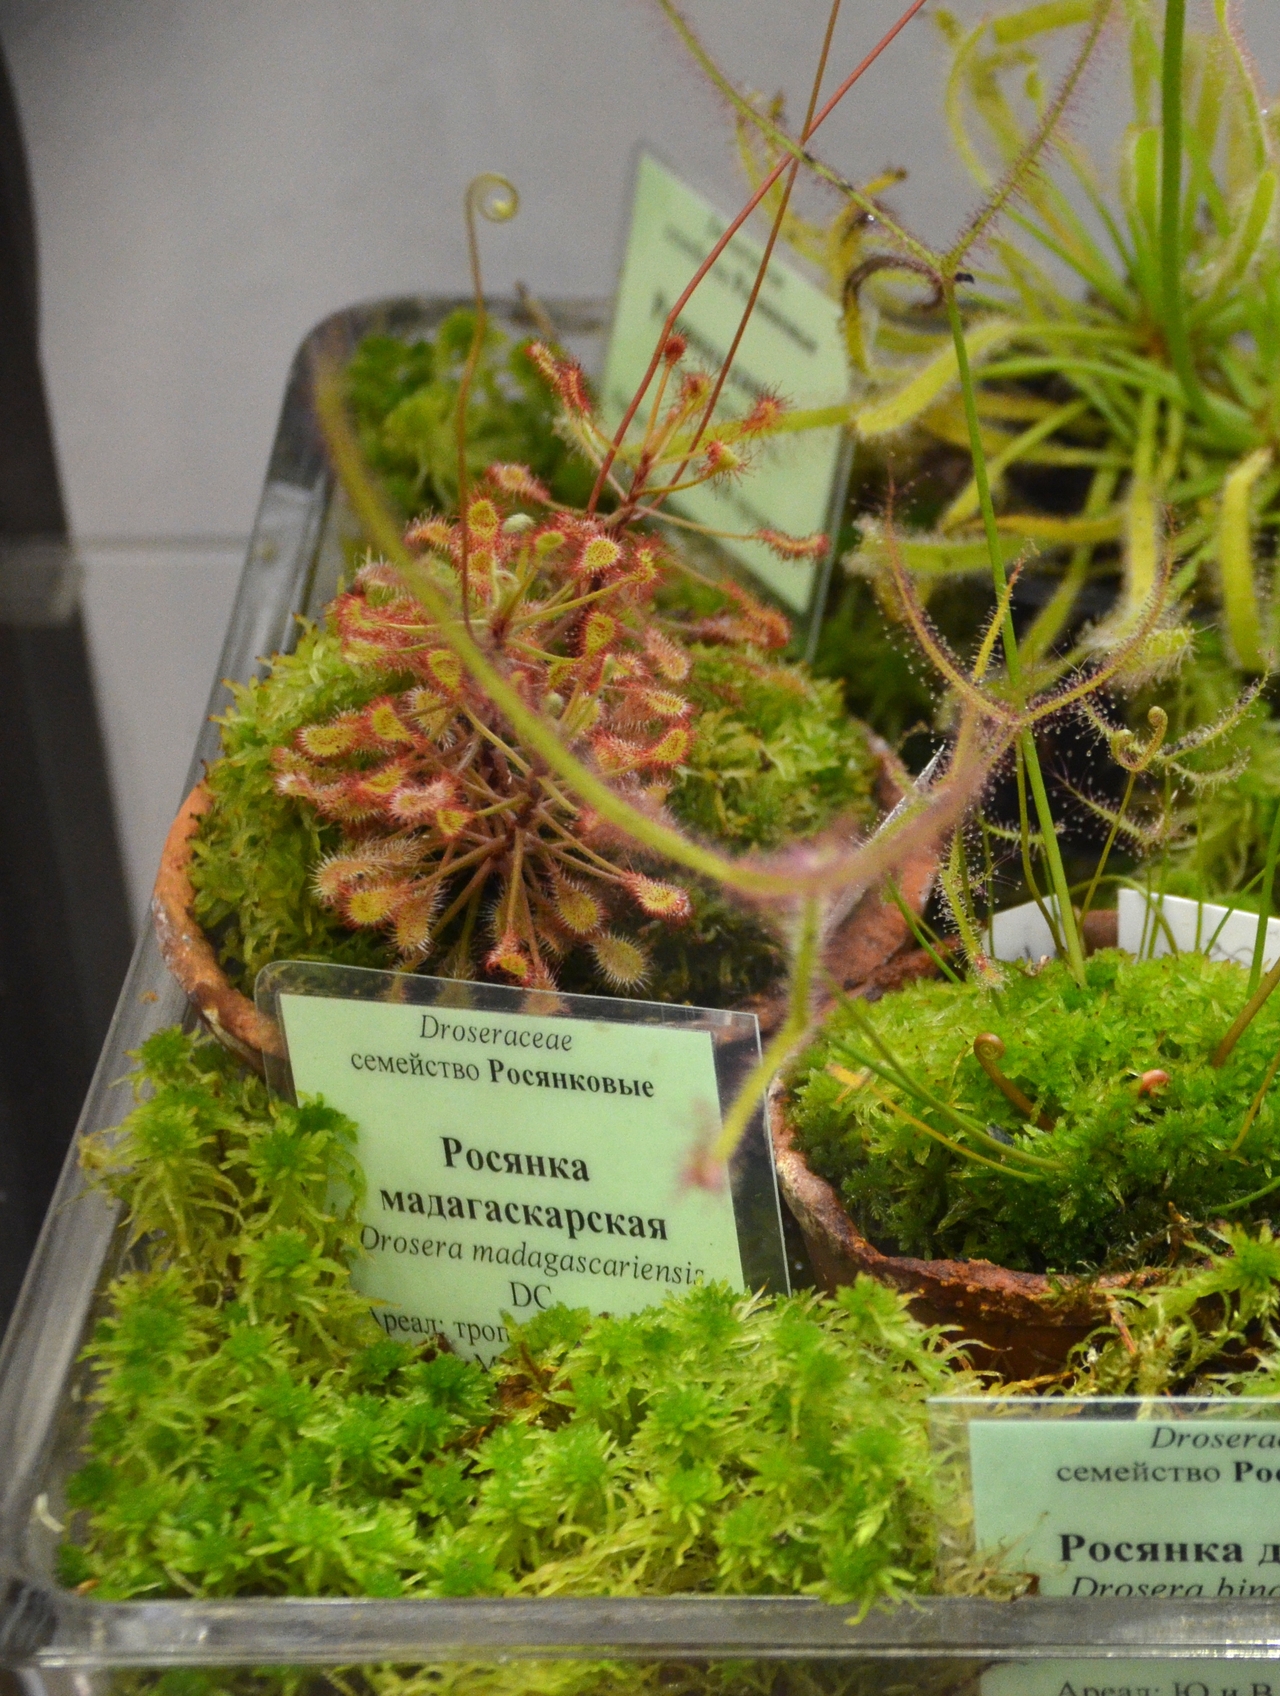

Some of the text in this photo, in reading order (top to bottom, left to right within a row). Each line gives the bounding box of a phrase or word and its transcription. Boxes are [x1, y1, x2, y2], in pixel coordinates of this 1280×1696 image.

[420, 1014, 573, 1051] Droseraceae
[350, 1051, 655, 1098] семейство Росянковые
[440, 1136, 590, 1182] Росянка
[379, 1187, 668, 1241] мадагаскарская
[359, 1225, 463, 1260] Drosera
[1056, 1459, 1221, 1485] семейство
[1058, 1533, 1244, 1564] Росянка
[1070, 1576, 1204, 1598] Drosera
